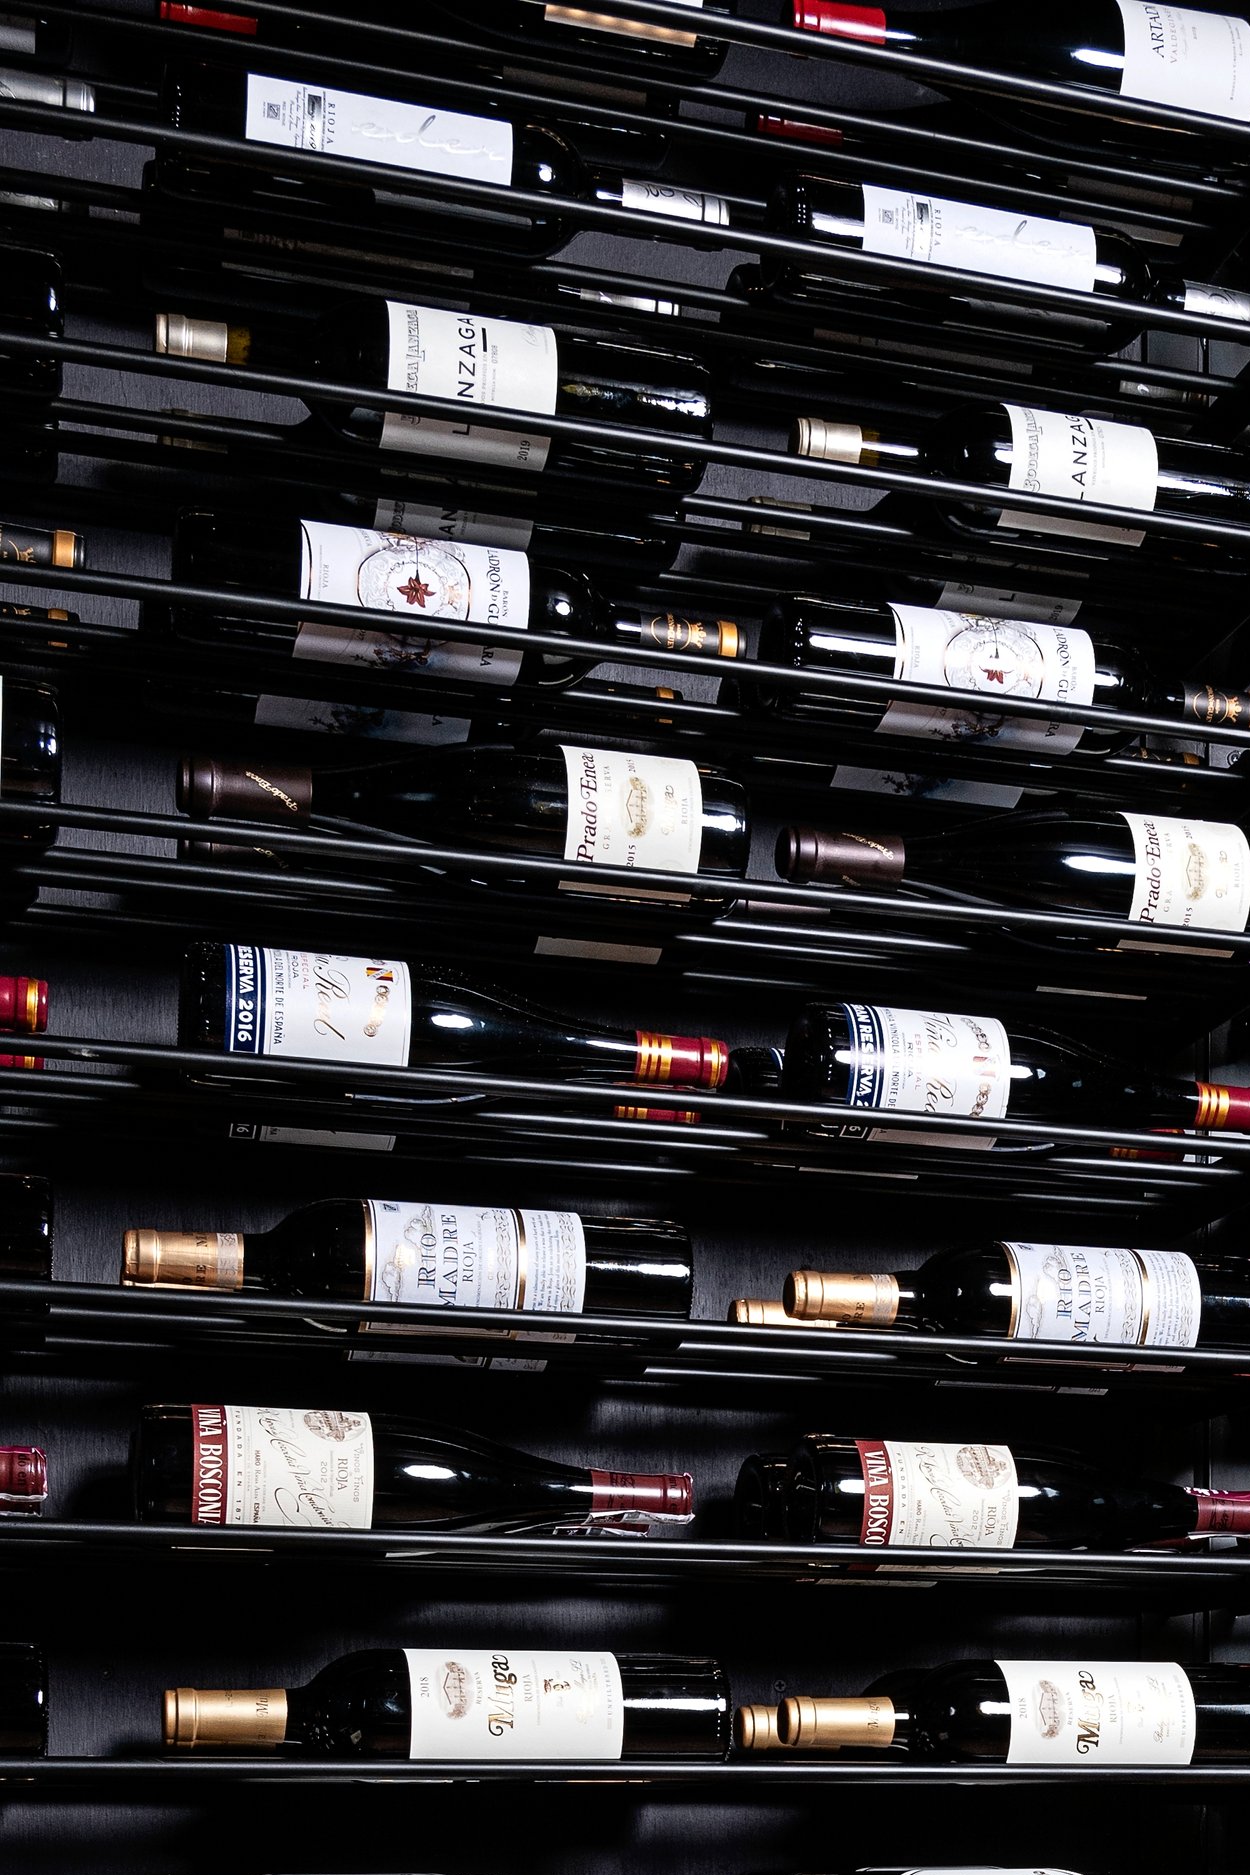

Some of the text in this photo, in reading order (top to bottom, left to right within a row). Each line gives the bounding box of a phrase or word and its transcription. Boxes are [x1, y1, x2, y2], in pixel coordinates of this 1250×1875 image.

[325, 102, 336, 145] RIOJA
[452, 318, 478, 436] LNZAGA
[517, 440, 530, 461] 2019
[576, 801, 597, 861] Prado
[238, 999, 253, 1042] 2016
[273, 1010, 286, 1045] ESPAÑA
[461, 1242, 475, 1283] RIOJA
[1093, 1276, 1106, 1314] RIOJA
[198, 1408, 225, 1436] VIÑA
[320, 1461, 328, 1483] 2012
[337, 1458, 347, 1490] RIOJA
[864, 1451, 891, 1486] VIÑA
[985, 1506, 996, 1536] RIOJA
[420, 1677, 430, 1697] 2018
[523, 1674, 533, 1702] RIOJA
[1017, 1697, 1028, 1718] 2018
[1107, 1694, 1117, 1723] RIOJA
